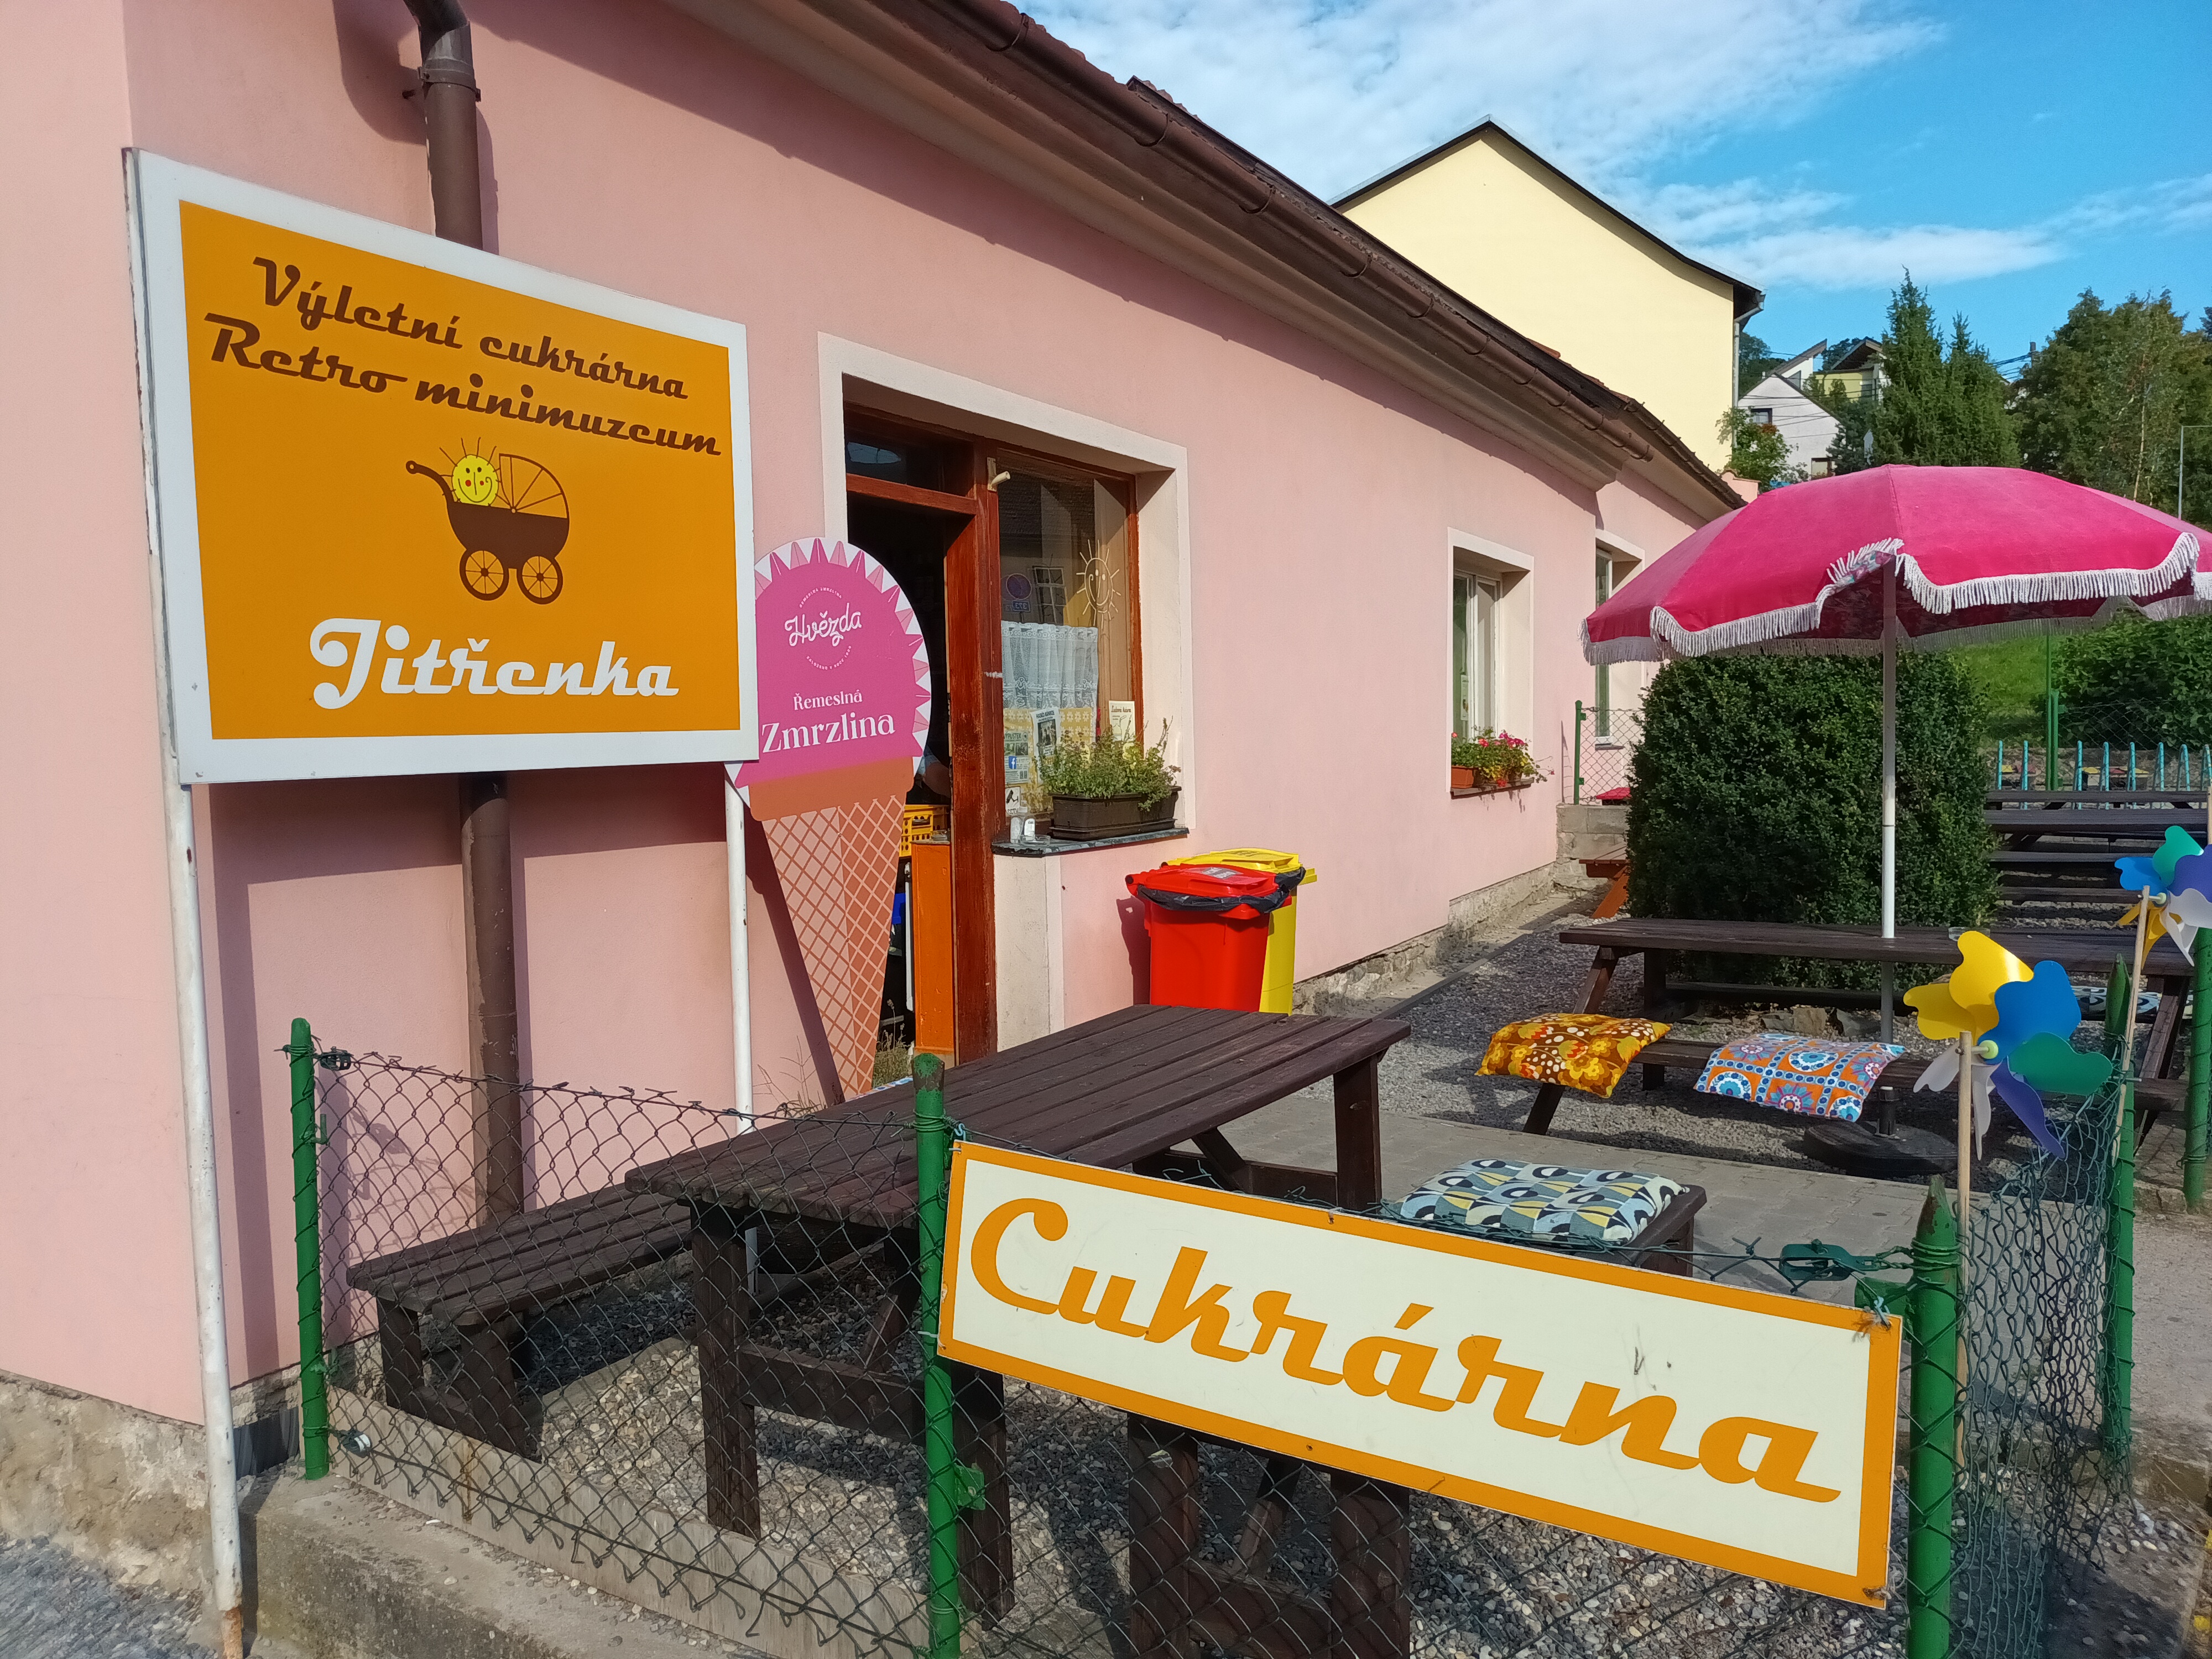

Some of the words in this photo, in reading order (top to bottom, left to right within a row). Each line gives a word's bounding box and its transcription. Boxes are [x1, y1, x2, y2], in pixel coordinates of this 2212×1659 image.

[253, 257, 463, 349] Výletní
[480, 335, 688, 399] cukrárna
[204, 312, 408, 393] Retro
[415, 373, 722, 456] minimuzeum
[310, 618, 679, 709] Jitřenka
[784, 602, 862, 646] Hvězda
[761, 712, 895, 753] Zmrzlina
[793, 689, 862, 711] Řemeslná
[970, 1197, 1842, 1503] Cukrárna
